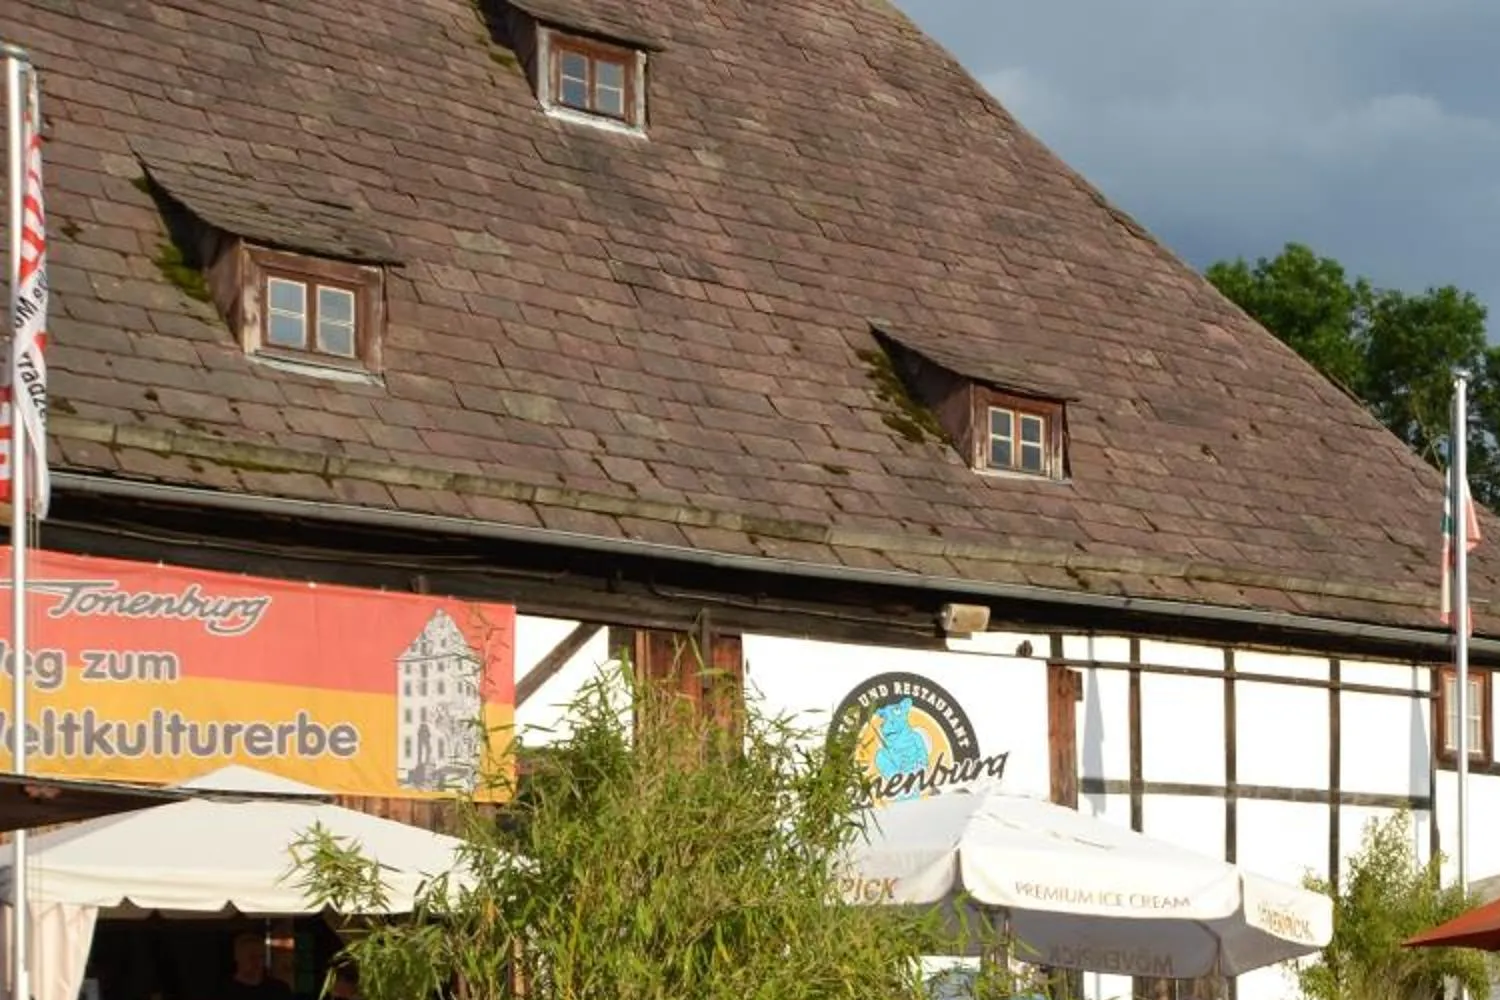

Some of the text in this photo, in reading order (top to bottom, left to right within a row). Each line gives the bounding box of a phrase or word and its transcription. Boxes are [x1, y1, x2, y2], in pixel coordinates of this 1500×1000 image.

[20, 575, 272, 635] Tonenburg
[0, 640, 178, 690] eg zum
[0, 708, 360, 757] eltkulturerbe
[858, 684, 889, 707] UND
[893, 681, 970, 748] RESTAURANT
[1015, 880, 1191, 910] PREMIUM ICE CREAM
